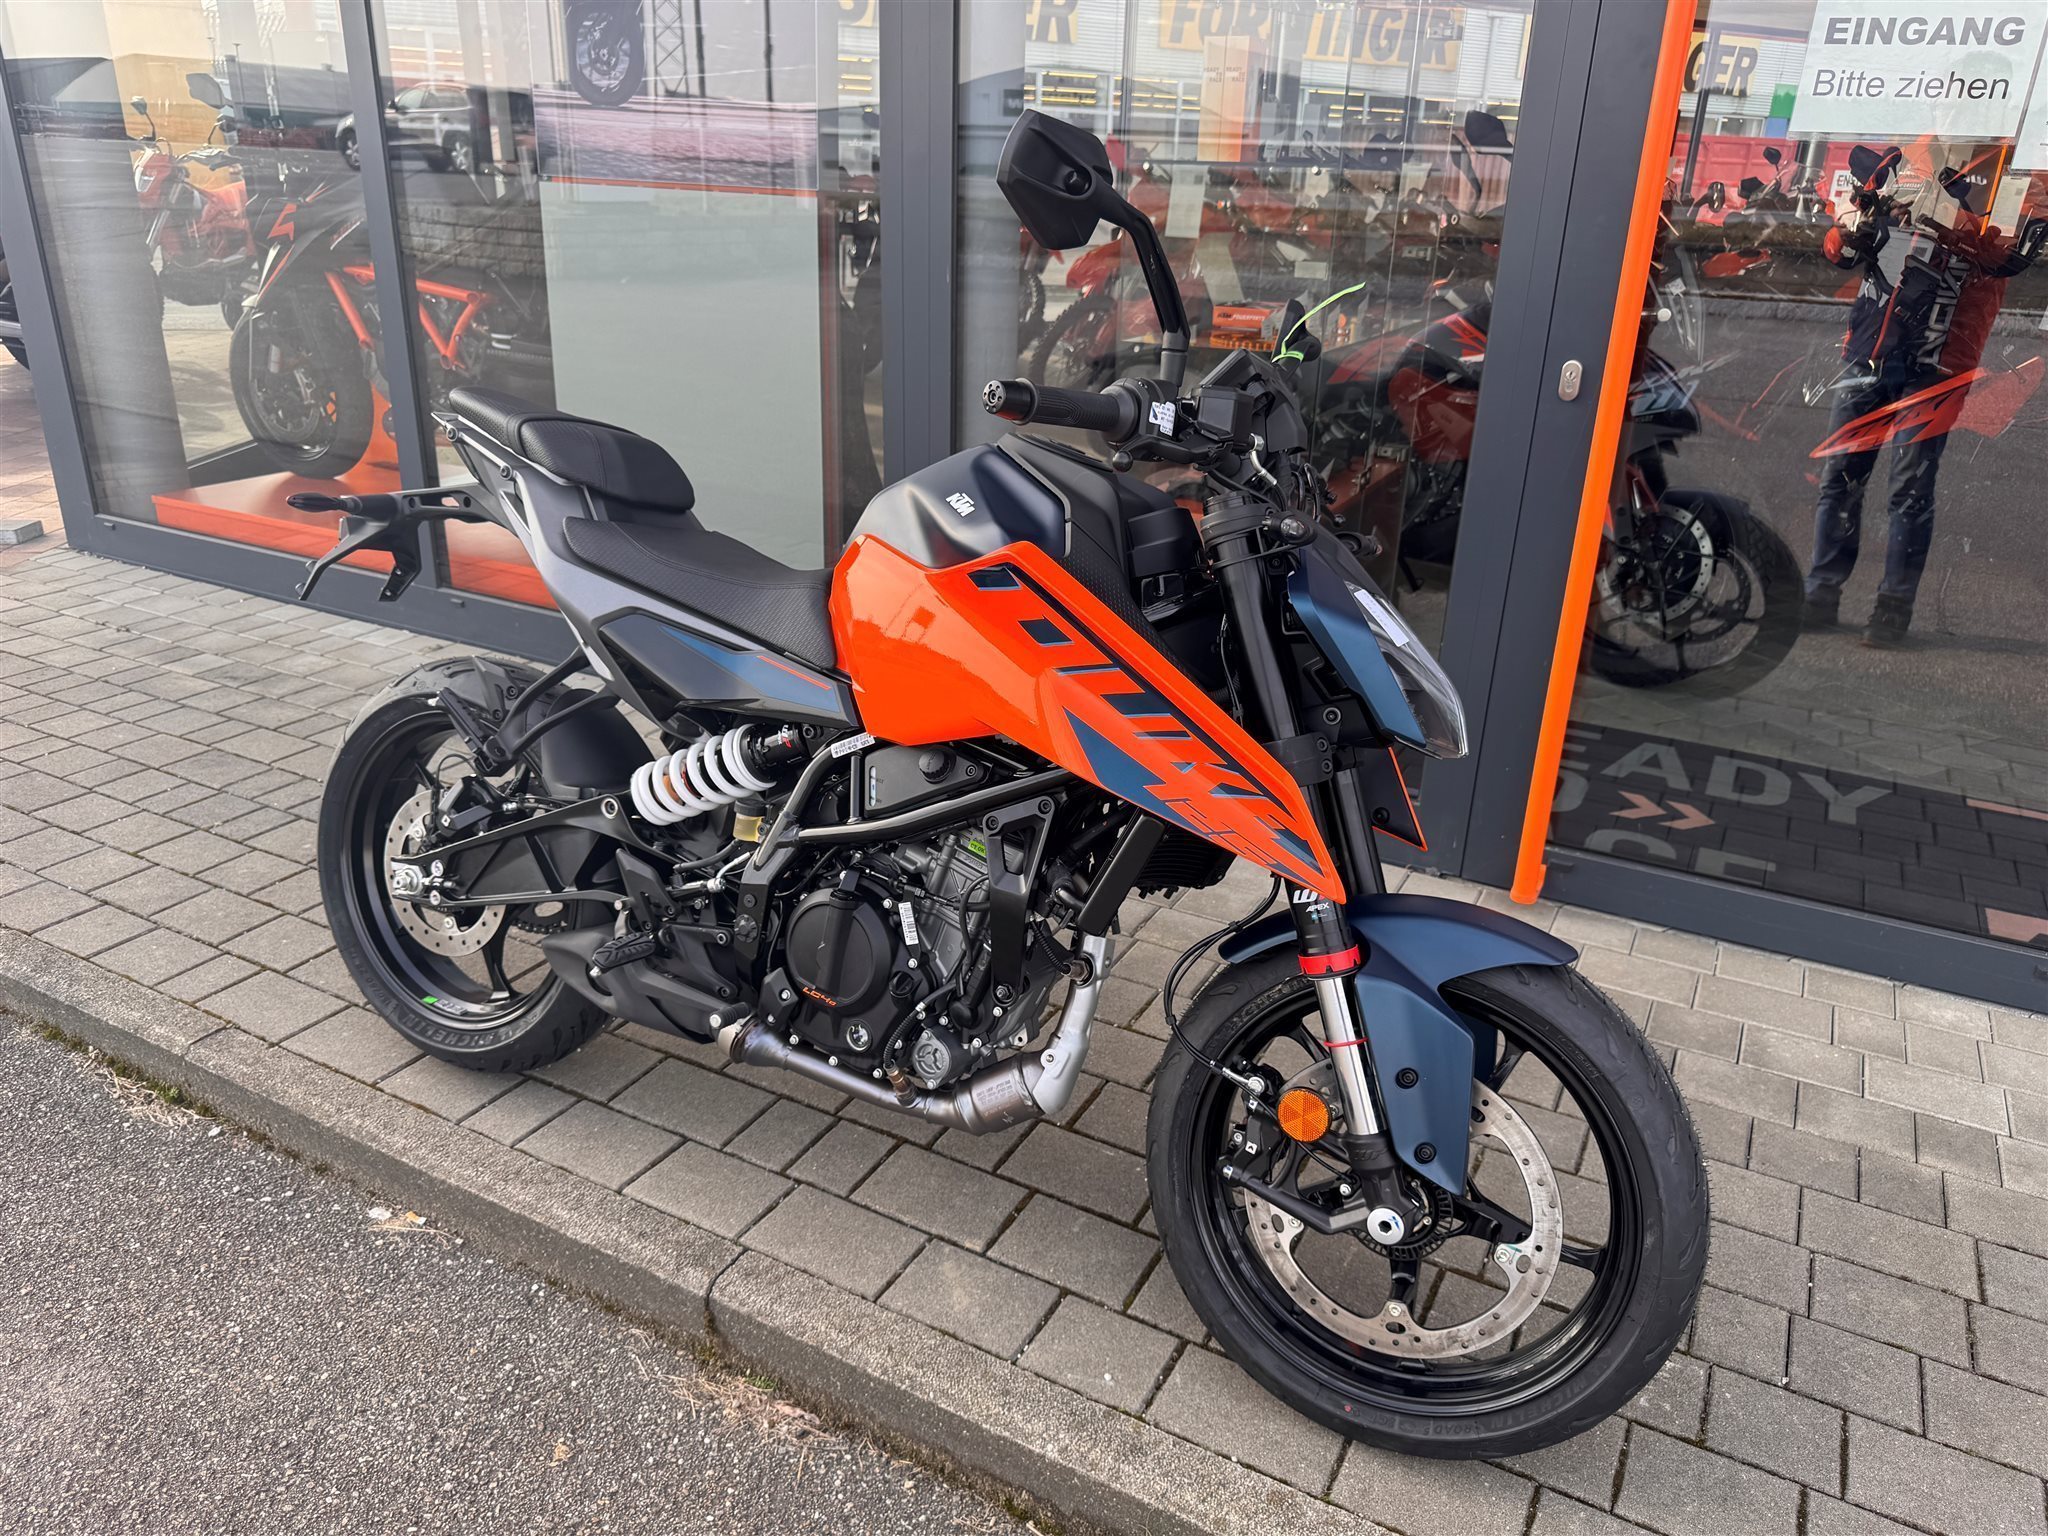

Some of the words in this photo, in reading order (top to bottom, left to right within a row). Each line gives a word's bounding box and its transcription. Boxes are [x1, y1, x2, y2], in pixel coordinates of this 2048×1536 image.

[1824, 17, 2026, 46] EINGANG
[1812, 70, 1885, 97] Bitte
[1894, 71, 2011, 100] ziehen
[945, 492, 976, 517] KTM
[1305, 903, 1330, 912] APEX
[1485, 1377, 1590, 1432] MICHELIN
